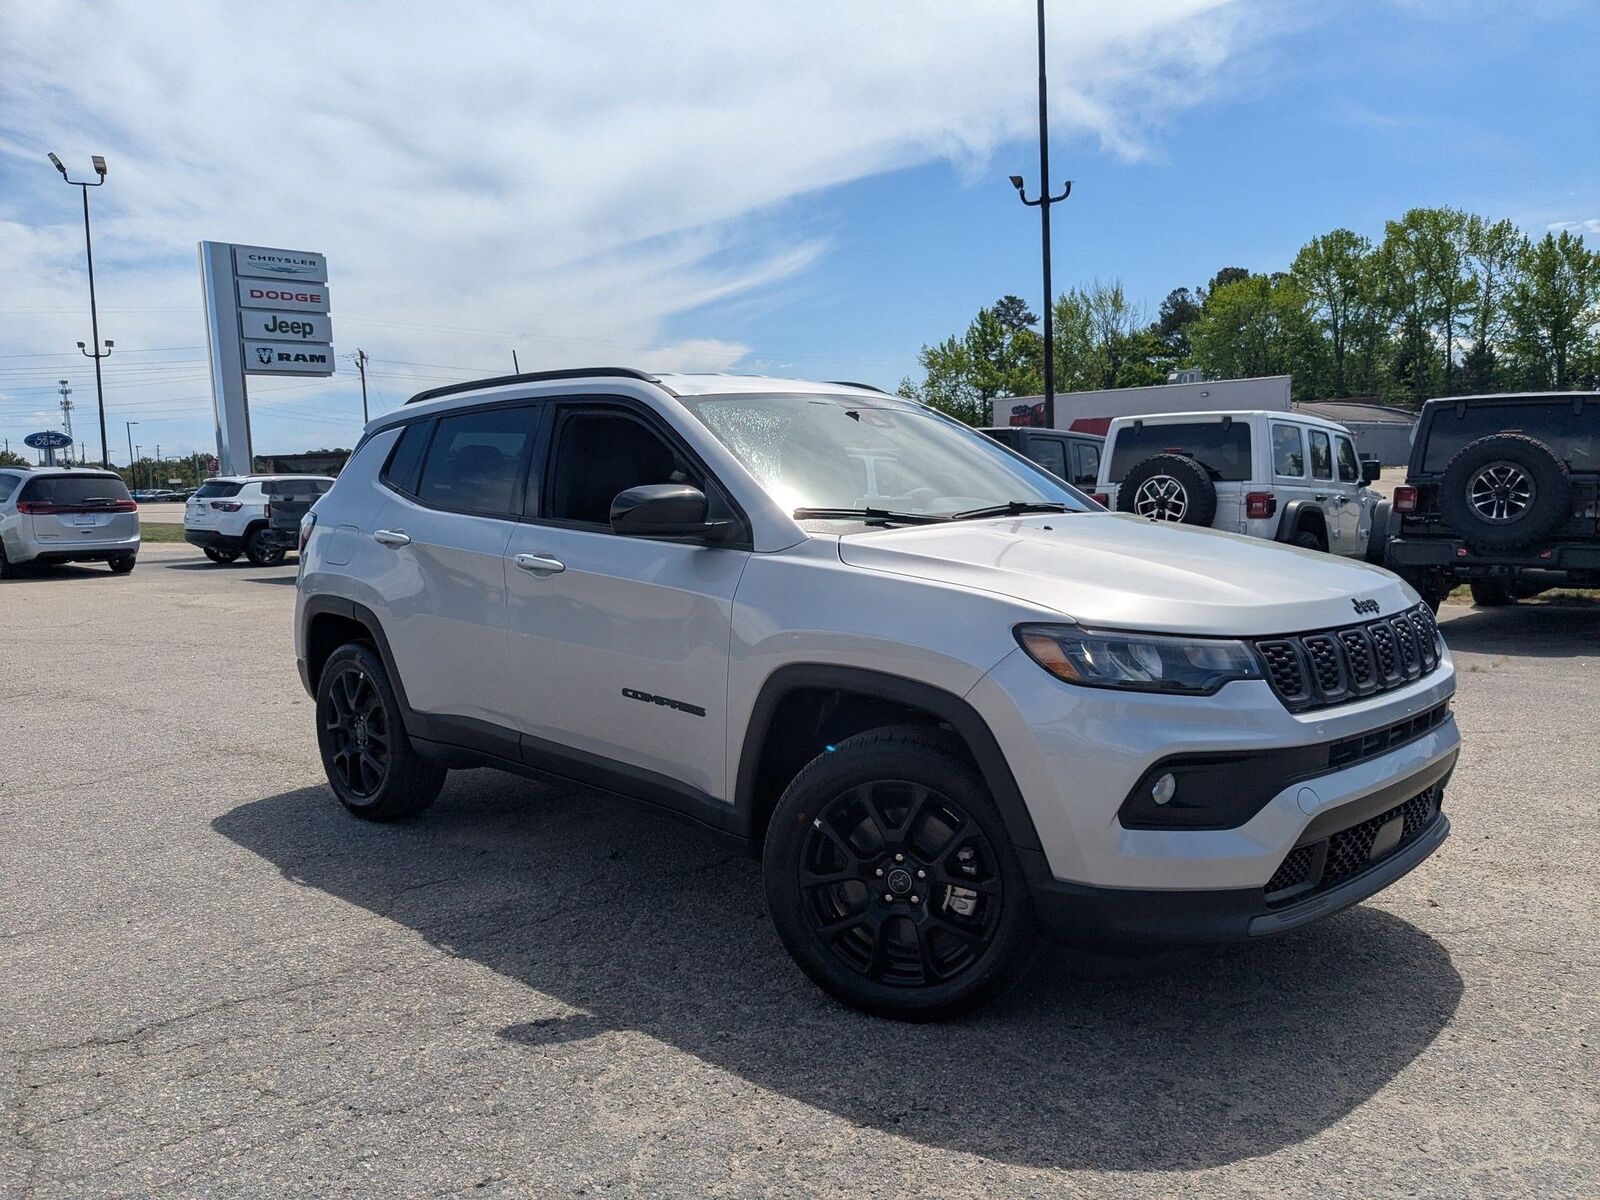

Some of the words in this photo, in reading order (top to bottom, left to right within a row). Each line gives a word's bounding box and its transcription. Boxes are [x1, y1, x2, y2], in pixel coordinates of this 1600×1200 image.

[248, 254, 317, 267] CHRYSLER
[250, 289, 322, 303] DODGE
[264, 315, 314, 338] Jeep
[277, 352, 326, 363] RAM
[34, 435, 63, 446] Ford
[1350, 598, 1380, 614] Jeep
[621, 687, 706, 717] COMPASS
